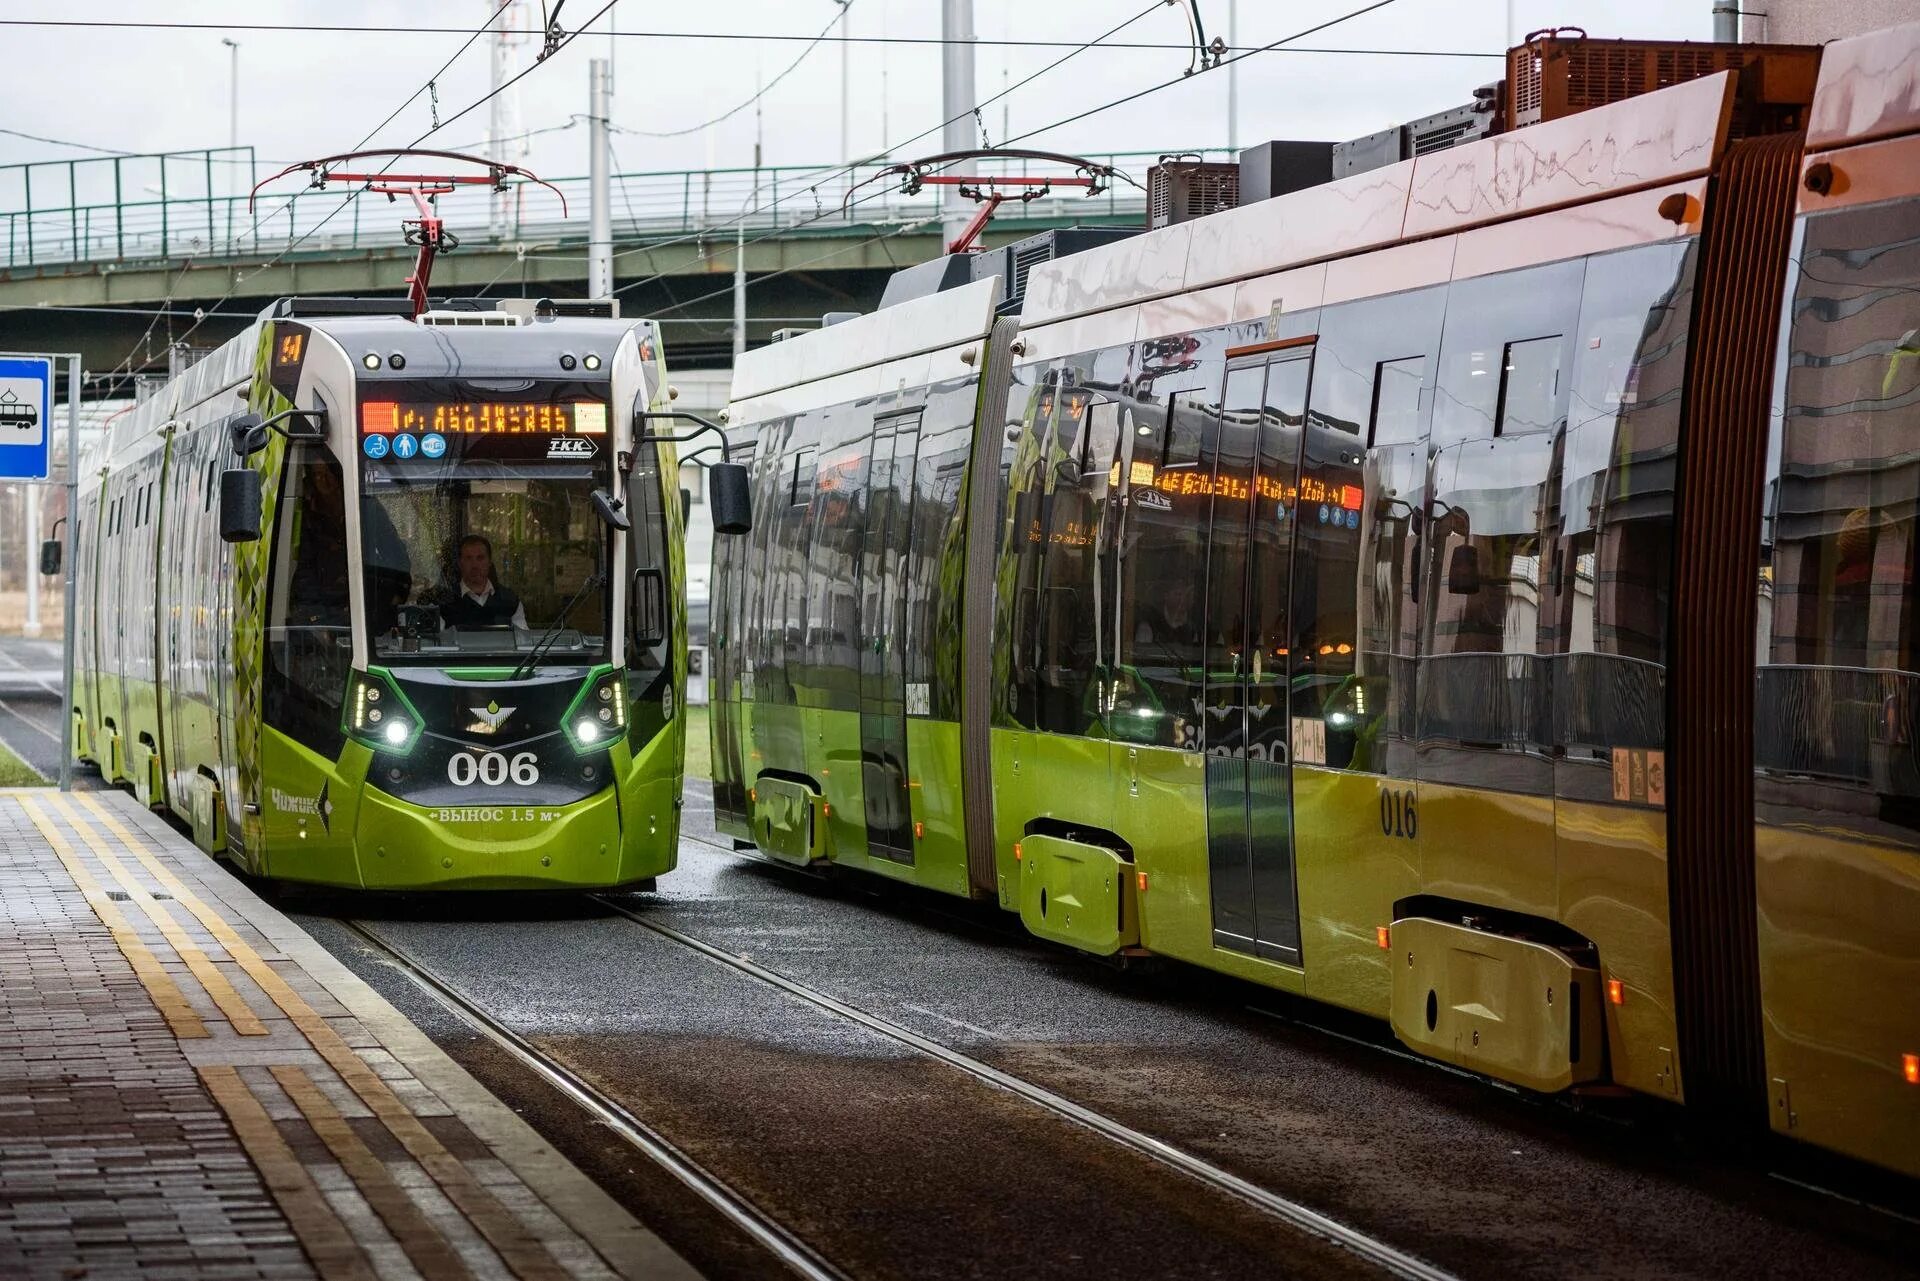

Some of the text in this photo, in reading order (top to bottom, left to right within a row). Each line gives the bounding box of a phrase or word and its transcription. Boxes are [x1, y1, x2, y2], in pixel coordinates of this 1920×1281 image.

[447, 752, 540, 786] 006
[440, 809, 504, 822] ВЫНОС
[511, 809, 535, 821] 1.5
[1380, 787, 1417, 840] 016
